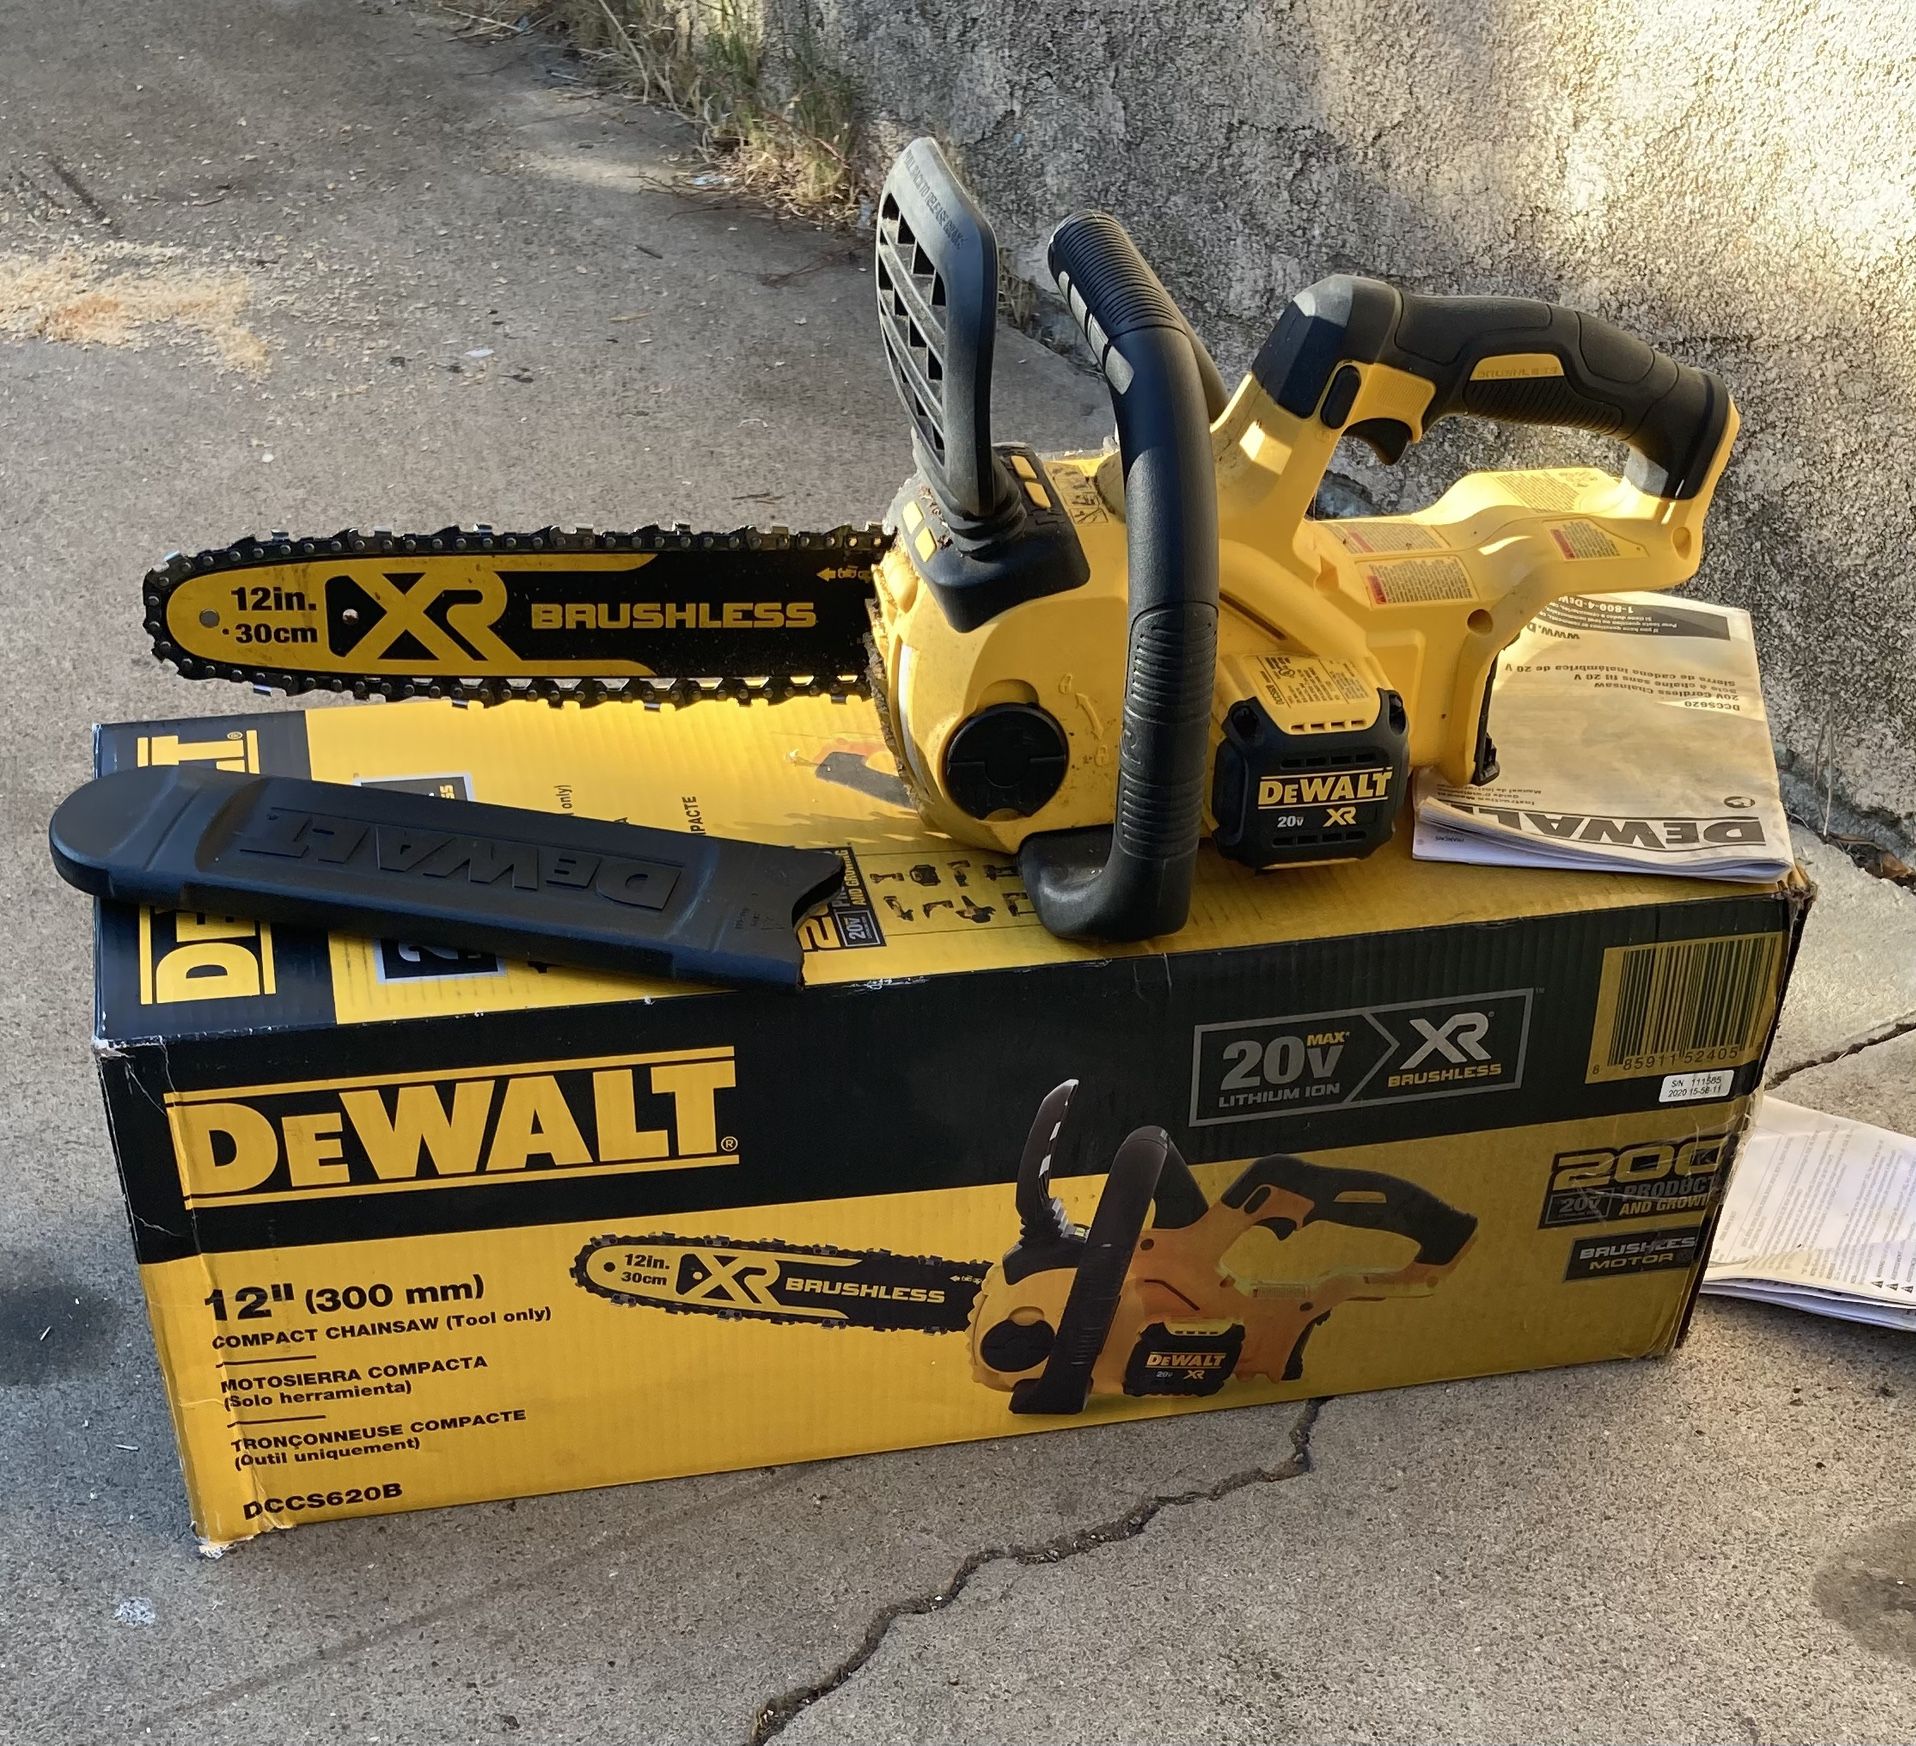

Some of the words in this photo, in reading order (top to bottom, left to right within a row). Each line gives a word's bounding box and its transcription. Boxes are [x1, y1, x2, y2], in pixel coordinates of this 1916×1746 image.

[231, 587, 317, 611] 12in.
[337, 571, 518, 660] XR
[532, 602, 817, 629] BRUSHLESS
[235, 623, 318, 644] 30cm
[1516, 664, 1532, 672] 20
[1593, 681, 1654, 695] Chainsaw
[1657, 688, 1712, 700] Cordless
[1684, 700, 1741, 712] DCCS620
[1258, 771, 1393, 805] DEWALT
[682, 796, 707, 835] PACTE
[1323, 806, 1357, 827] XR
[239, 810, 682, 910] DEWALT
[1400, 1012, 1492, 1070] XR
[1592, 1064, 1600, 1075] 8
[1623, 1052, 1676, 1071] 85911
[1684, 1046, 1738, 1064] 52405
[1388, 1064, 1502, 1088] BRUSHLESS
[1219, 1088, 1301, 1107] LITHIUM
[1305, 1083, 1340, 1098] ION
[1668, 1088, 1688, 1098] 2020
[167, 1059, 736, 1196] DEWALT
[1619, 1201, 1651, 1216] AND
[623, 1253, 671, 1270] 12in.
[1589, 1252, 1674, 1271] MOTOR
[621, 1270, 668, 1287] 30cm
[691, 1254, 783, 1305] XR
[785, 1277, 945, 1304] BRUSHLESS
[204, 1283, 296, 1321] 12"
[305, 1283, 394, 1315] (300
[405, 1274, 485, 1305] mm)
[211, 1328, 319, 1350] COMPACT
[325, 1317, 439, 1340] CHAINSAW
[446, 1311, 496, 1331] (Tool
[503, 1306, 552, 1324] only)
[221, 1368, 363, 1393] MOTOSIERRA
[367, 1355, 489, 1379] COMPACTA
[1146, 1354, 1226, 1367] DEWALT
[1183, 1369, 1206, 1380] XR
[223, 1394, 273, 1412] (Solo
[279, 1379, 412, 1405] herramienta)
[231, 1423, 404, 1453] TRONÇONNEUSE
[409, 1409, 527, 1434] COMPACTE
[234, 1452, 288, 1472] (Outil
[294, 1437, 421, 1464] uniquement)
[242, 1483, 404, 1521] DCCS620B
